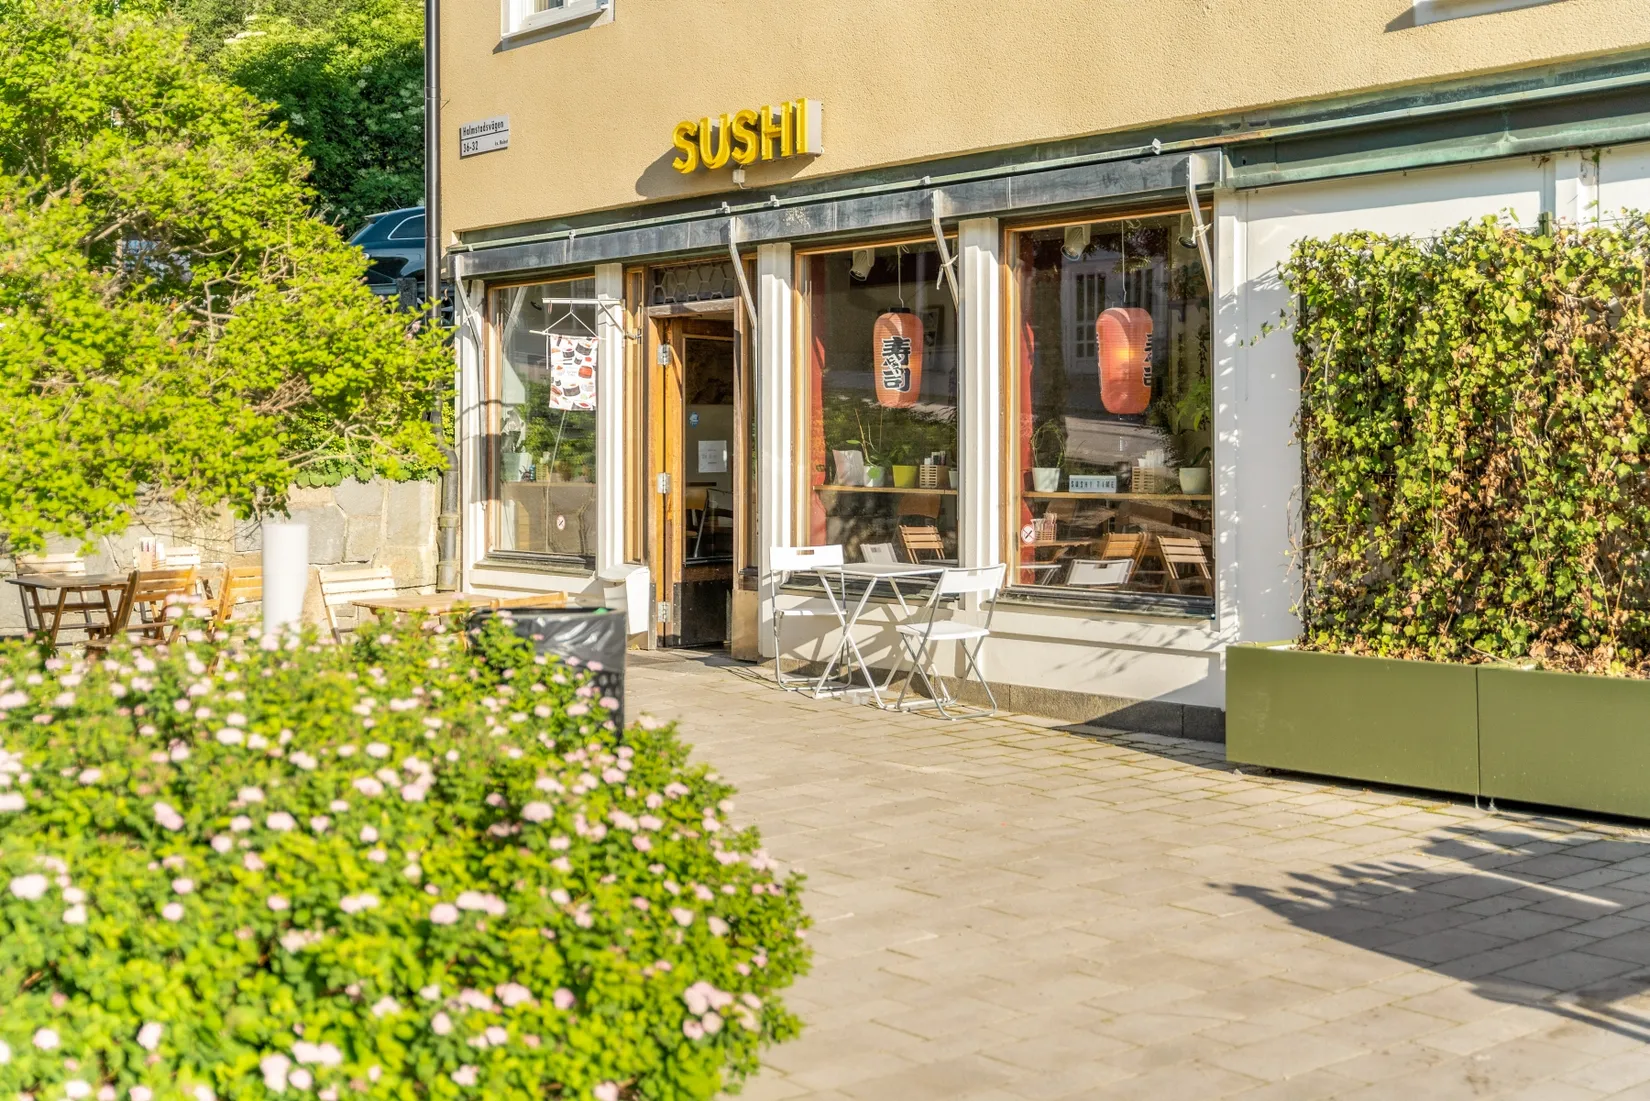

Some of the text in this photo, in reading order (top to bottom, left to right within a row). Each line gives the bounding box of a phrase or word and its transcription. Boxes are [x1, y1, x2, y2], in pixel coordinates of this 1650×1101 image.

[463, 121, 503, 136] Halmstadsvägen
[671, 97, 809, 174] SUSHI
[463, 140, 478, 152] 36-32
